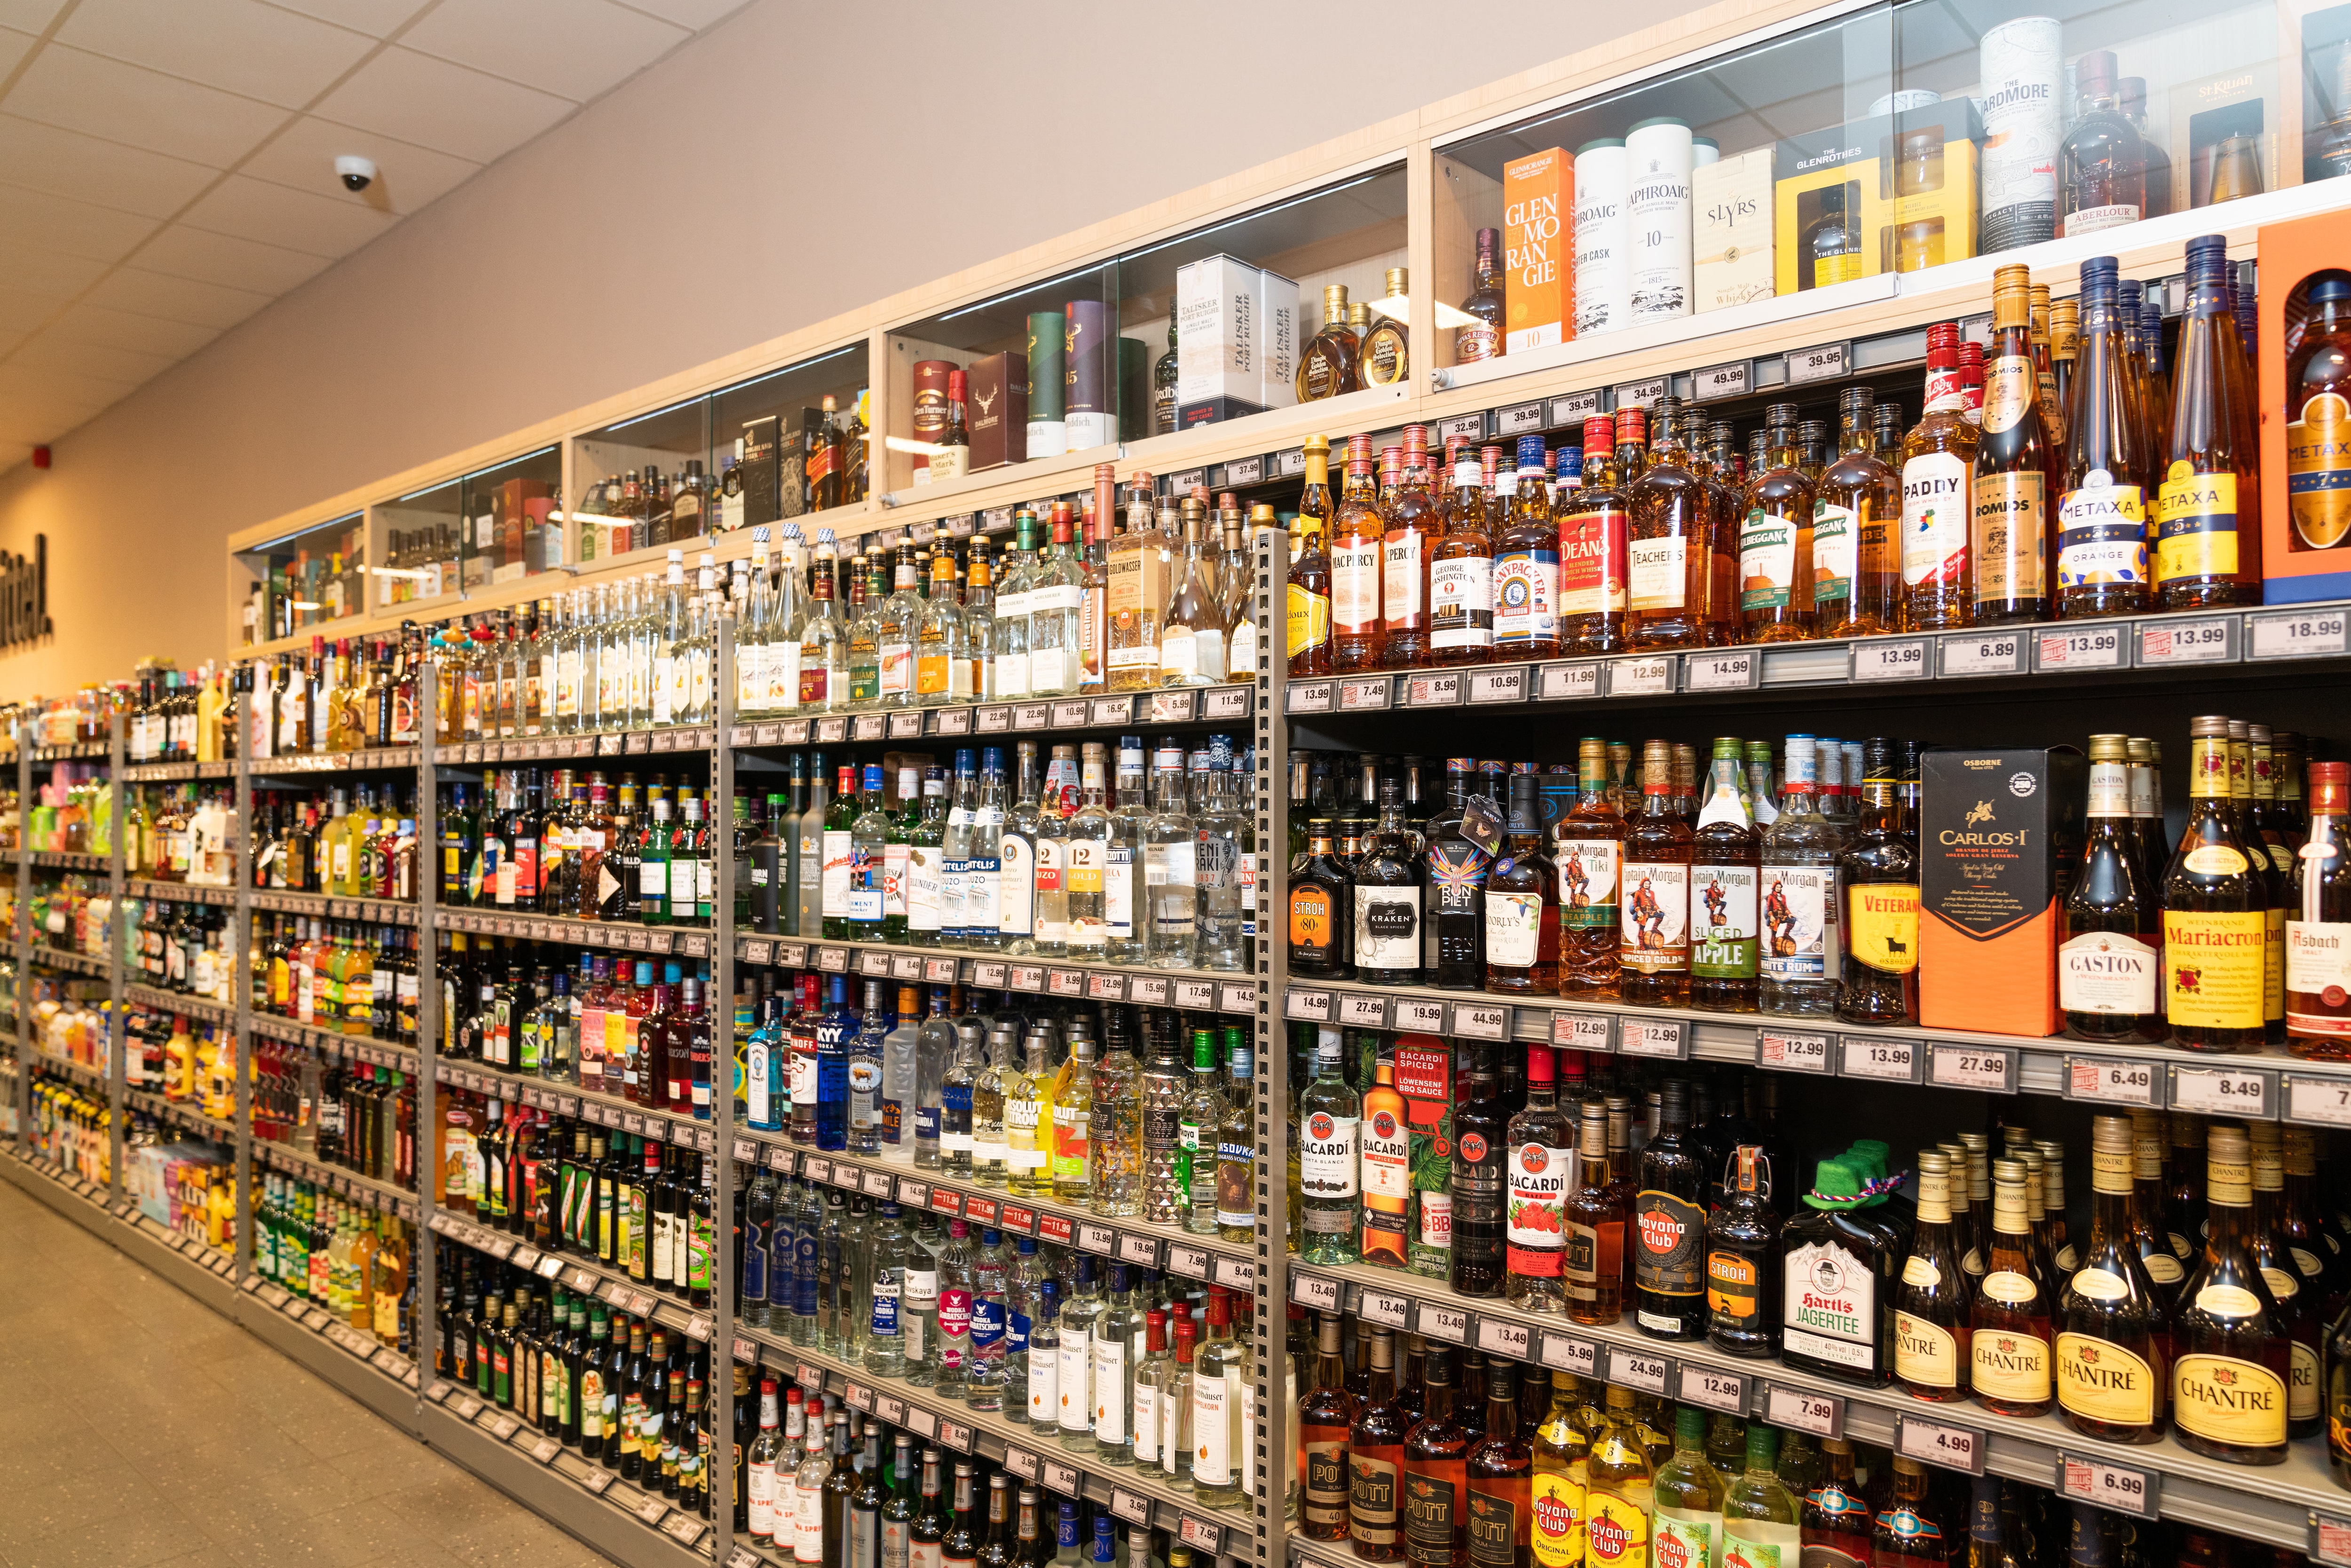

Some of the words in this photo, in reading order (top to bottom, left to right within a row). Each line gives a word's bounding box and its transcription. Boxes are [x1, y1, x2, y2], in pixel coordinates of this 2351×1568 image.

[1982, 84, 2049, 115] ARDMORE
[1797, 147, 1861, 170] GLENROTHES
[1509, 156, 1552, 176] GLENMORANGIE
[1626, 184, 1688, 209] LAPHROAIG
[1506, 193, 1557, 227] GLEN
[1708, 196, 1756, 228] SLYRS
[1986, 206, 2013, 221] LEGACY
[2075, 208, 2130, 223] ABERLOUR
[1524, 216, 1560, 244] MO
[1506, 240, 1546, 271] RAN
[1590, 249, 1609, 260] CASK
[1523, 260, 1555, 287] GIE
[1181, 299, 1217, 315] TALISKER
[1180, 314, 1192, 323] PORT
[1476, 330, 1496, 339] REGAL
[1526, 330, 1540, 348] 10
[1467, 343, 1475, 352] 12
[1808, 352, 1840, 367] 39.95
[1713, 370, 1743, 384] 49.99
[1634, 386, 1662, 399] 34.99
[975, 417, 998, 427] DALMORE
[1515, 409, 1539, 422] 39.99
[1455, 420, 1479, 433] 32.99
[1239, 463, 1258, 474] 37.99
[1904, 478, 1959, 500] PADDY
[2158, 490, 2219, 512] METAXA
[1976, 499, 2028, 518] ROMIOS
[2064, 501, 2134, 521] METAXA
[1740, 530, 1785, 550] KILBEGGAN
[1561, 537, 1611, 562] DEAN'S
[1333, 557, 1346, 569] MAC
[1347, 555, 1374, 568] PERCY
[2073, 551, 2123, 562] ORANGE
[1110, 561, 1141, 575] GOLDWASSER
[1436, 565, 1464, 575] GEORGE
[1569, 560, 1594, 569] BLENDED
[1504, 607, 1527, 615] BOURBON
[1082, 595, 1092, 650] Haselnuss
[2288, 622, 2342, 637] 18.99
[2069, 636, 2115, 651] 13.99
[1980, 644, 2014, 657] 6.89
[1633, 666, 1665, 678] 12.99
[1713, 661, 1747, 674] 14.99
[1364, 685, 1384, 696] 7.49
[1435, 680, 1456, 691] 8.99
[1222, 695, 1243, 705] 11.99
[1305, 689, 1328, 699] 13.99
[1173, 700, 1189, 709] 5.99
[1066, 708, 1084, 717] 10.99
[1073, 849, 1090, 865] 12
[1575, 843, 1609, 858] Morgan
[1196, 858, 1218, 871] RAKI
[1587, 859, 1608, 873] Tiki
[1645, 867, 1682, 884] Morgan
[1442, 886, 1471, 897] RON
[1441, 896, 1470, 906] PIET
[1294, 901, 1324, 916] STROH
[1372, 914, 1410, 923] KRAKEN
[1485, 916, 1520, 928] DOORLY'S
[1561, 913, 1602, 922] PINEAPPLE
[2186, 919, 2245, 928] WEINBRAND
[1302, 918, 1315, 931] 80
[1695, 927, 1742, 938] SLICED
[2167, 928, 2262, 946] Mariacron
[2292, 930, 2339, 950] Asbach
[1652, 954, 1678, 964] GOLD
[1694, 944, 1743, 964] APPLE
[941, 963, 953, 972] 6.99
[1760, 959, 1784, 971] WHITE
[1786, 961, 1812, 972] RUM
[2070, 955, 2142, 974] GASTON
[987, 968, 1003, 977] 12.99
[1065, 976, 1080, 984] 9.99
[1144, 983, 1165, 993] 15.99
[1190, 987, 1210, 997] 17.99
[1303, 997, 1327, 1008] 14.99
[1356, 1002, 1382, 1013] 27.99
[1413, 1008, 1440, 1019] 19.99
[1473, 1013, 1501, 1024] 44.99
[1574, 1022, 1606, 1034] 12.99
[1400, 1052, 1443, 1063] BACARDÍ
[1870, 1048, 1910, 1063] 13.99
[1400, 1060, 1434, 1070] SPICED
[1399, 1077, 1443, 1087] LÖWENSENF
[2111, 1071, 2148, 1086] 6.49
[1399, 1085, 1415, 1093] BBQ
[1417, 1087, 1443, 1096] SAUCE
[2220, 1079, 2261, 1097] 8.49
[1364, 1141, 1407, 1156] BACARDÍ
[815, 1163, 828, 1172] 12.99
[2212, 1166, 2245, 1177] CHANTRÉ
[844, 1170, 858, 1179] 10.99
[1510, 1173, 1564, 1191] BACARDÍ
[1051, 1223, 1071, 1234] 11.99
[1638, 1213, 1685, 1234] Havana
[1092, 1234, 1111, 1243] 13.99
[1644, 1231, 1673, 1247] Club
[1188, 1254, 1205, 1266] 7.99
[1415, 1252, 1446, 1262] LIMITED
[1235, 1267, 1253, 1278] 9.49
[1415, 1261, 1446, 1272] EDITION
[1711, 1261, 1746, 1280] STROH
[1310, 1284, 1335, 1297] 13.49
[1796, 1307, 1859, 1334] JAGERTEE
[1498, 1328, 1527, 1344] 13.49
[1568, 1345, 1593, 1359] 5.99
[1825, 1343, 1837, 1351] 40%
[1799, 1346, 1856, 1362] PUNSCH-EXTRAKT
[1976, 1347, 2042, 1371] CHANTRÉ
[1630, 1361, 1664, 1378] 24.99
[1704, 1379, 1739, 1396] 12.99
[2181, 1377, 2273, 1410] CHANTRÉ
[1937, 1433, 1970, 1452] 4.99
[1060, 1472, 1074, 1484] 5.69
[1351, 1482, 1389, 1501] POTT
[1129, 1499, 1145, 1512] 3.99
[1406, 1495, 1446, 1521] POTT
[1200, 1527, 1216, 1540] 7.99
[1588, 1513, 1633, 1541] Havana
[1361, 1531, 1372, 1540] 40
[1536, 1540, 1570, 1556] ORIGINAL
[1593, 1533, 1620, 1555] Club
[1418, 1550, 1428, 1560] 54
